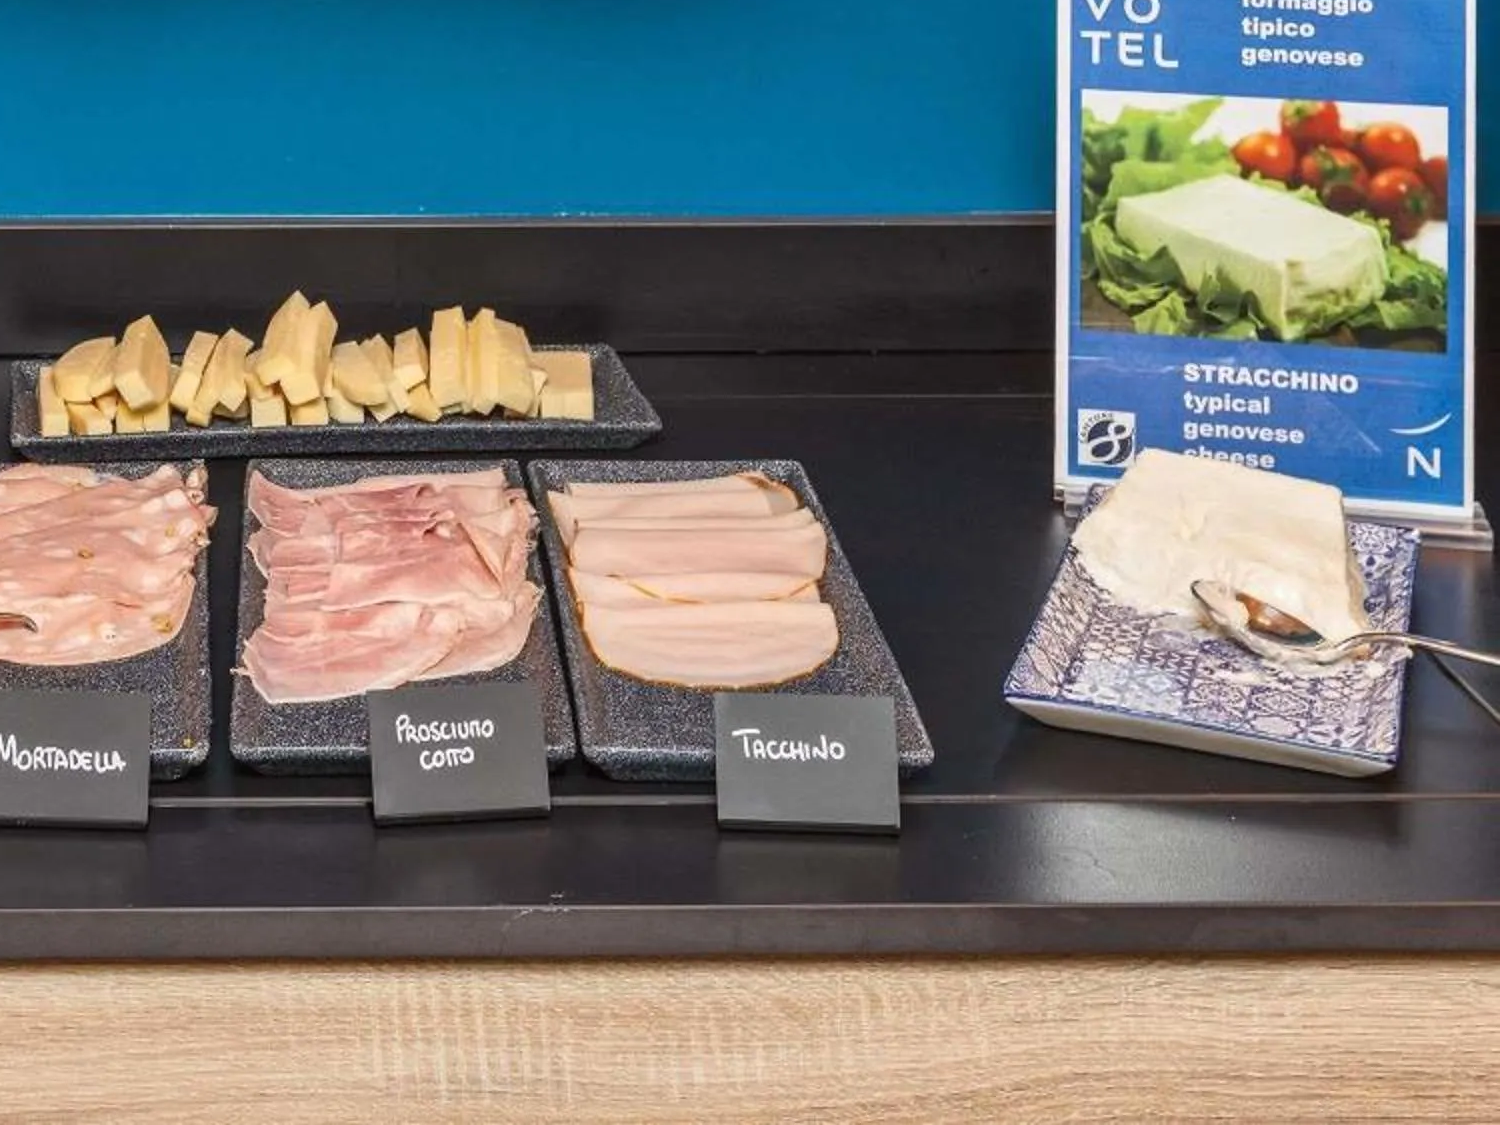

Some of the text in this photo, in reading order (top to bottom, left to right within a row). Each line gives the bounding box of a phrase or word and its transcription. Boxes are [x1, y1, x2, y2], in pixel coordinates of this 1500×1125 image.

[1242, 17, 1314, 39] tipico
[1081, 31, 1178, 67] TEL
[1242, 48, 1363, 66] genovese
[1183, 363, 1359, 394] STRACCHINO
[1184, 391, 1269, 414] typical
[1184, 422, 1304, 443] genovese
[1408, 447, 1440, 477] N
